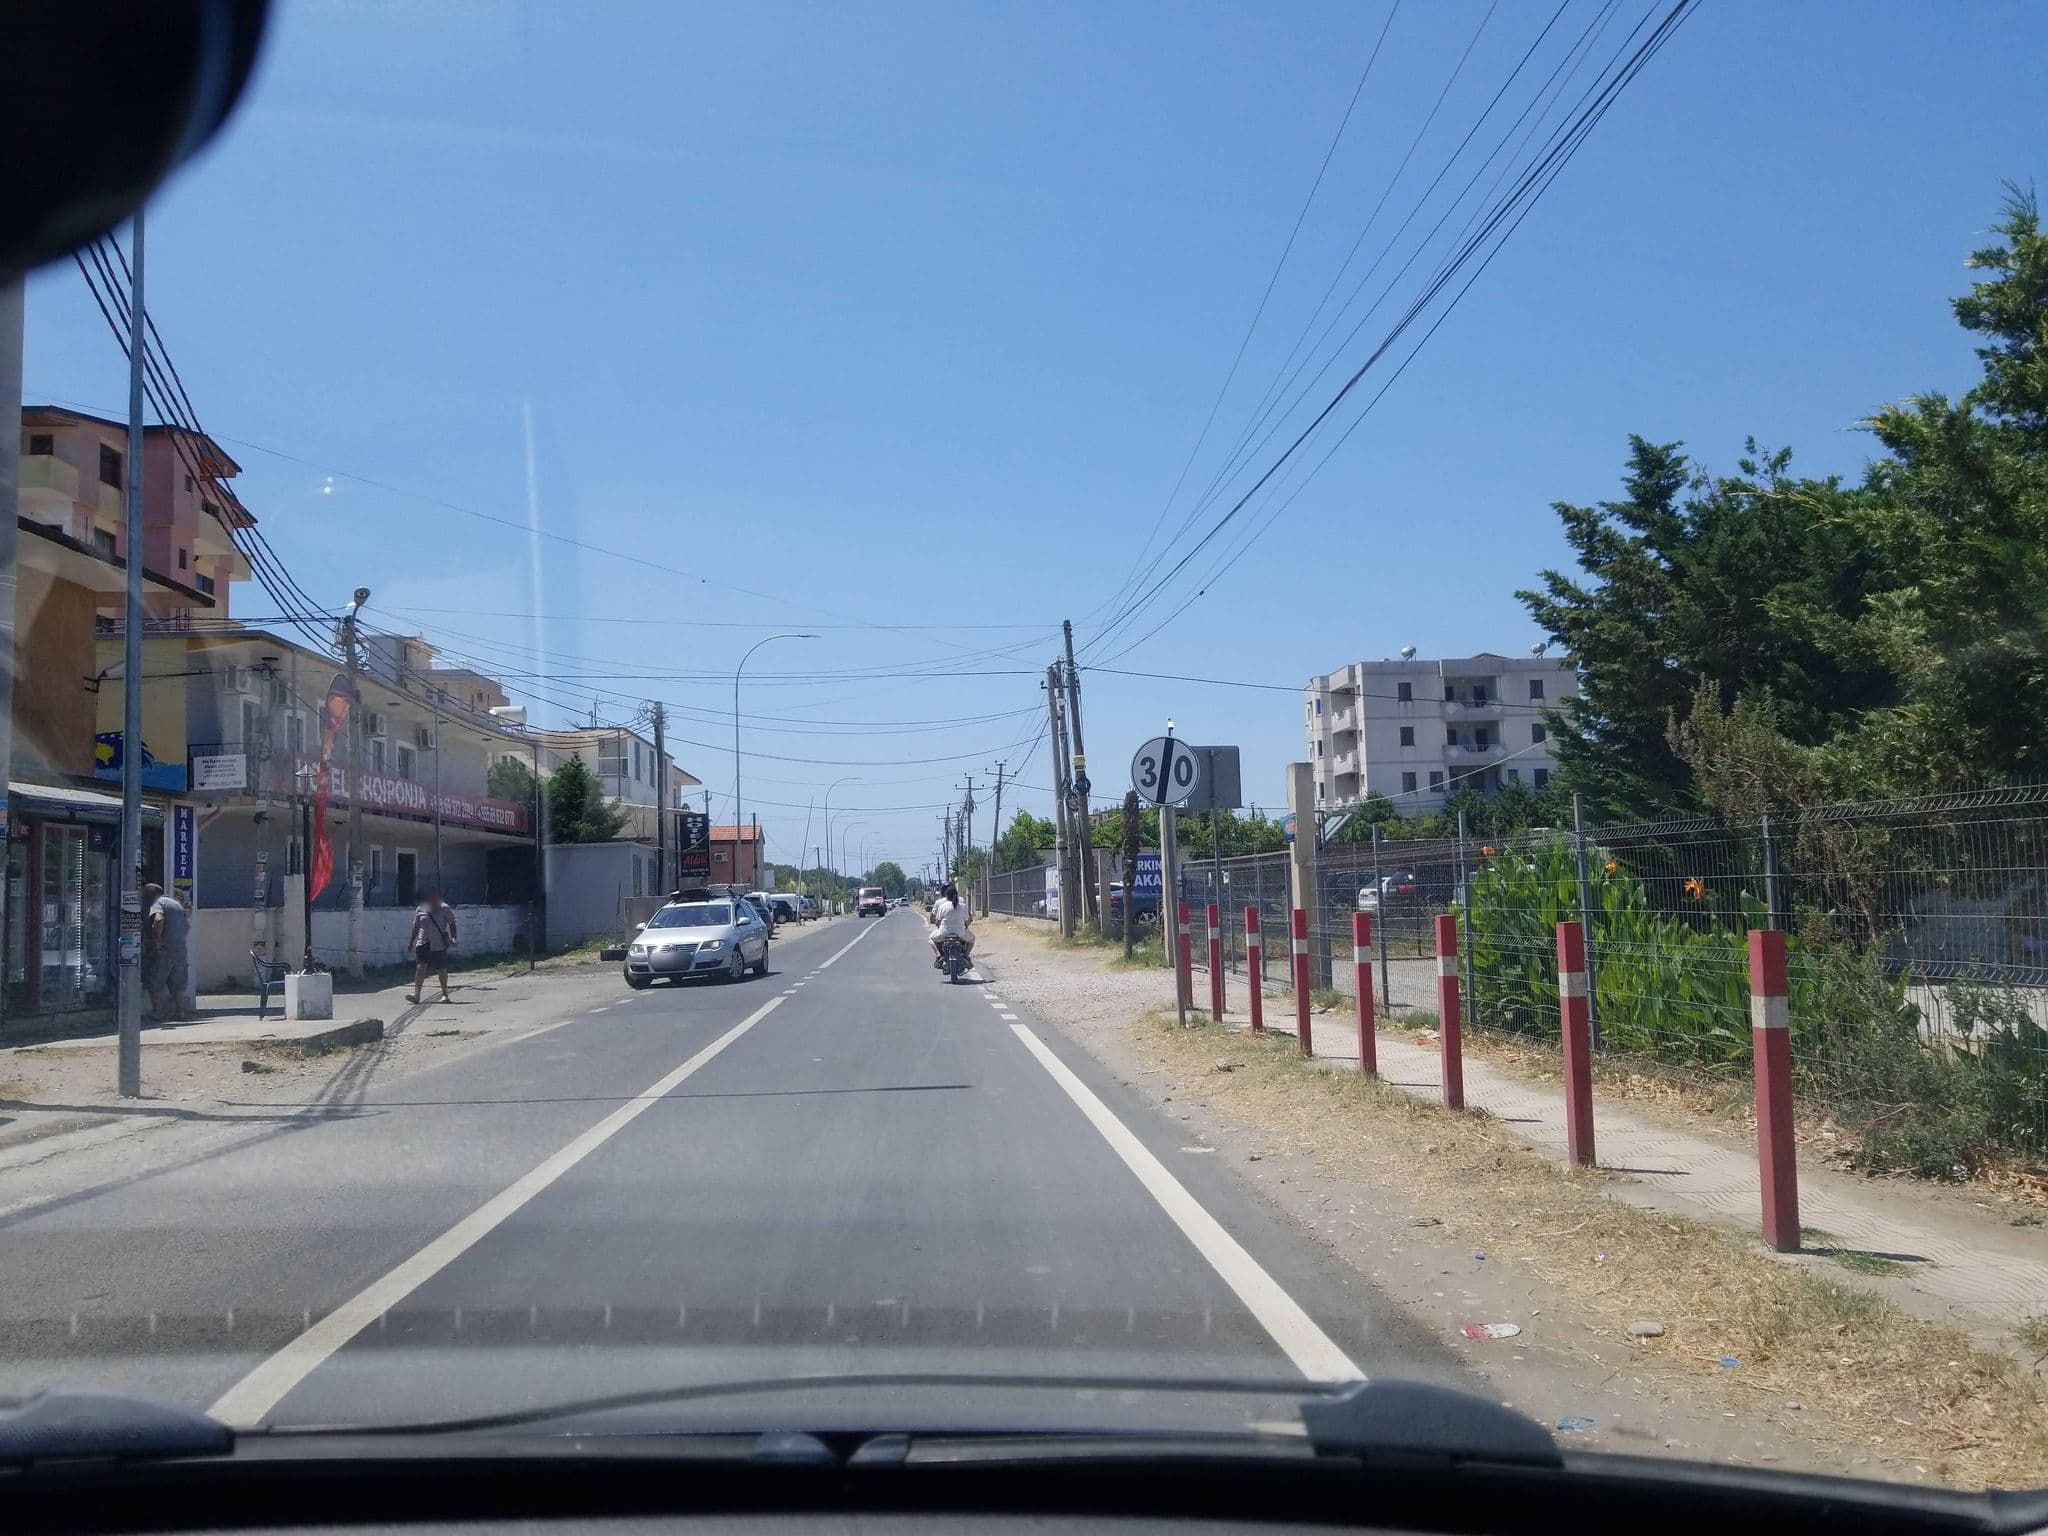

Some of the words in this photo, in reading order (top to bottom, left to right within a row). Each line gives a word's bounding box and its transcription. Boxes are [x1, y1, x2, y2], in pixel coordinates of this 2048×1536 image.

[1140, 756, 1193, 787] 30
[360, 775, 427, 809] HQIPONJA
[180, 808, 188, 876] MARKET
[1136, 860, 1162, 871] RKIN
